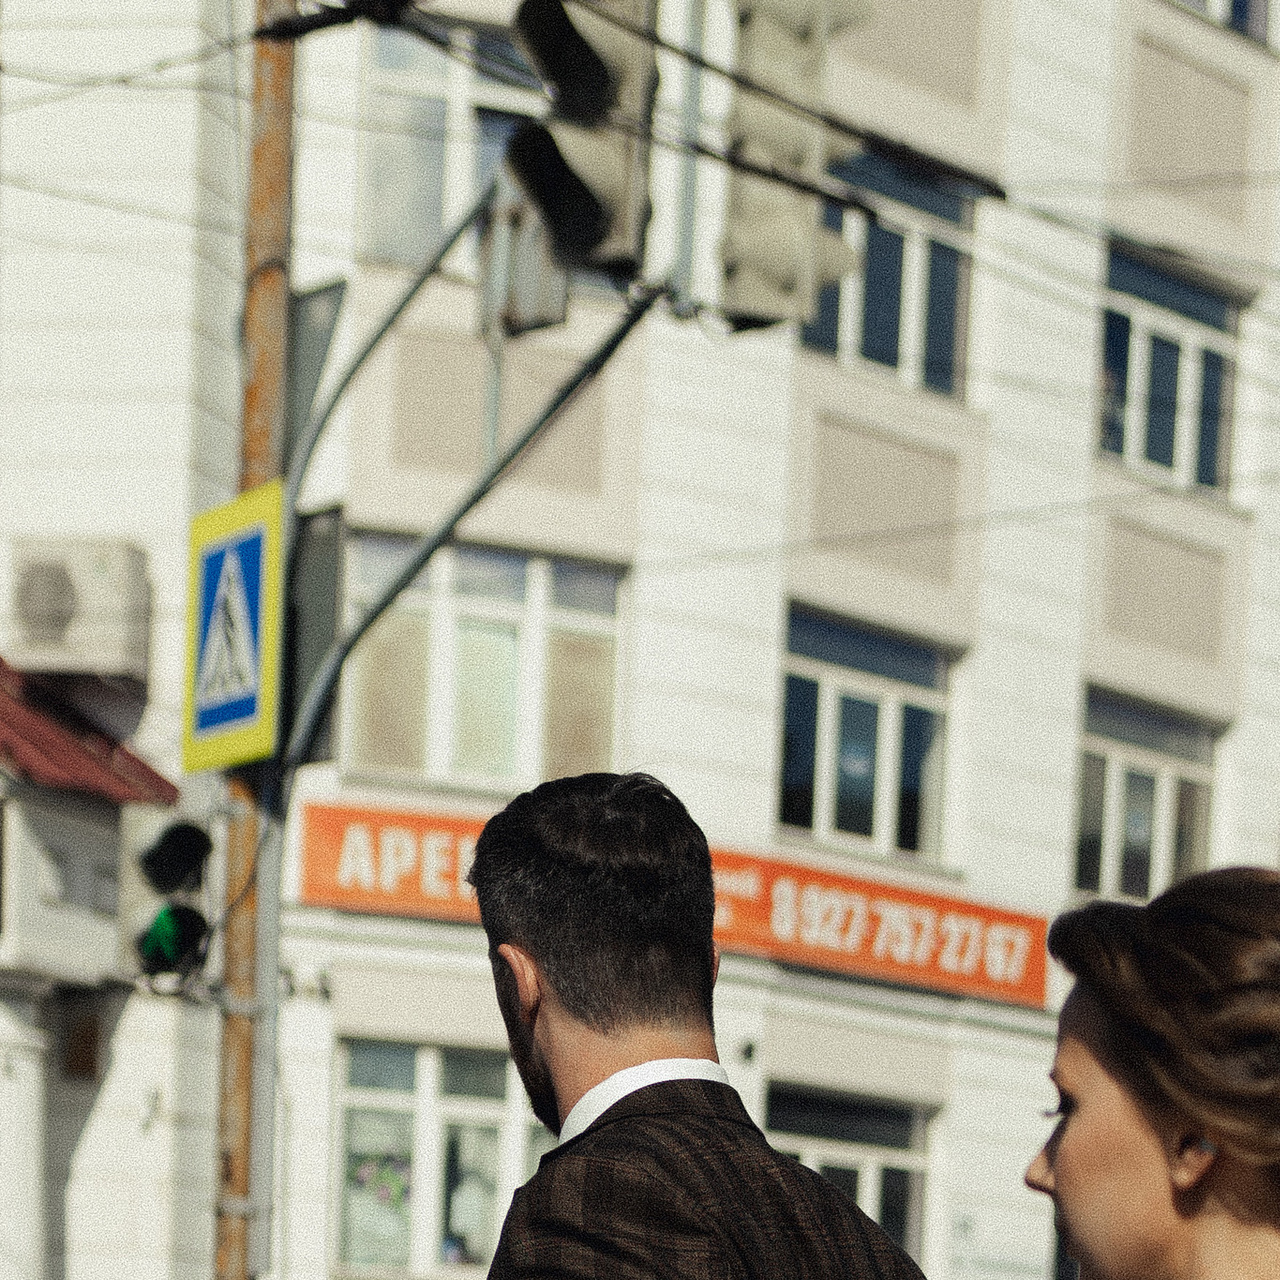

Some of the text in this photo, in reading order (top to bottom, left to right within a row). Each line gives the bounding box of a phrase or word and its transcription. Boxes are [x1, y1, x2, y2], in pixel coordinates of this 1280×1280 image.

[770, 877, 797, 942] 8
[801, 884, 867, 954] 927
[871, 898, 936, 967] 757
[938, 912, 983, 975] 27
